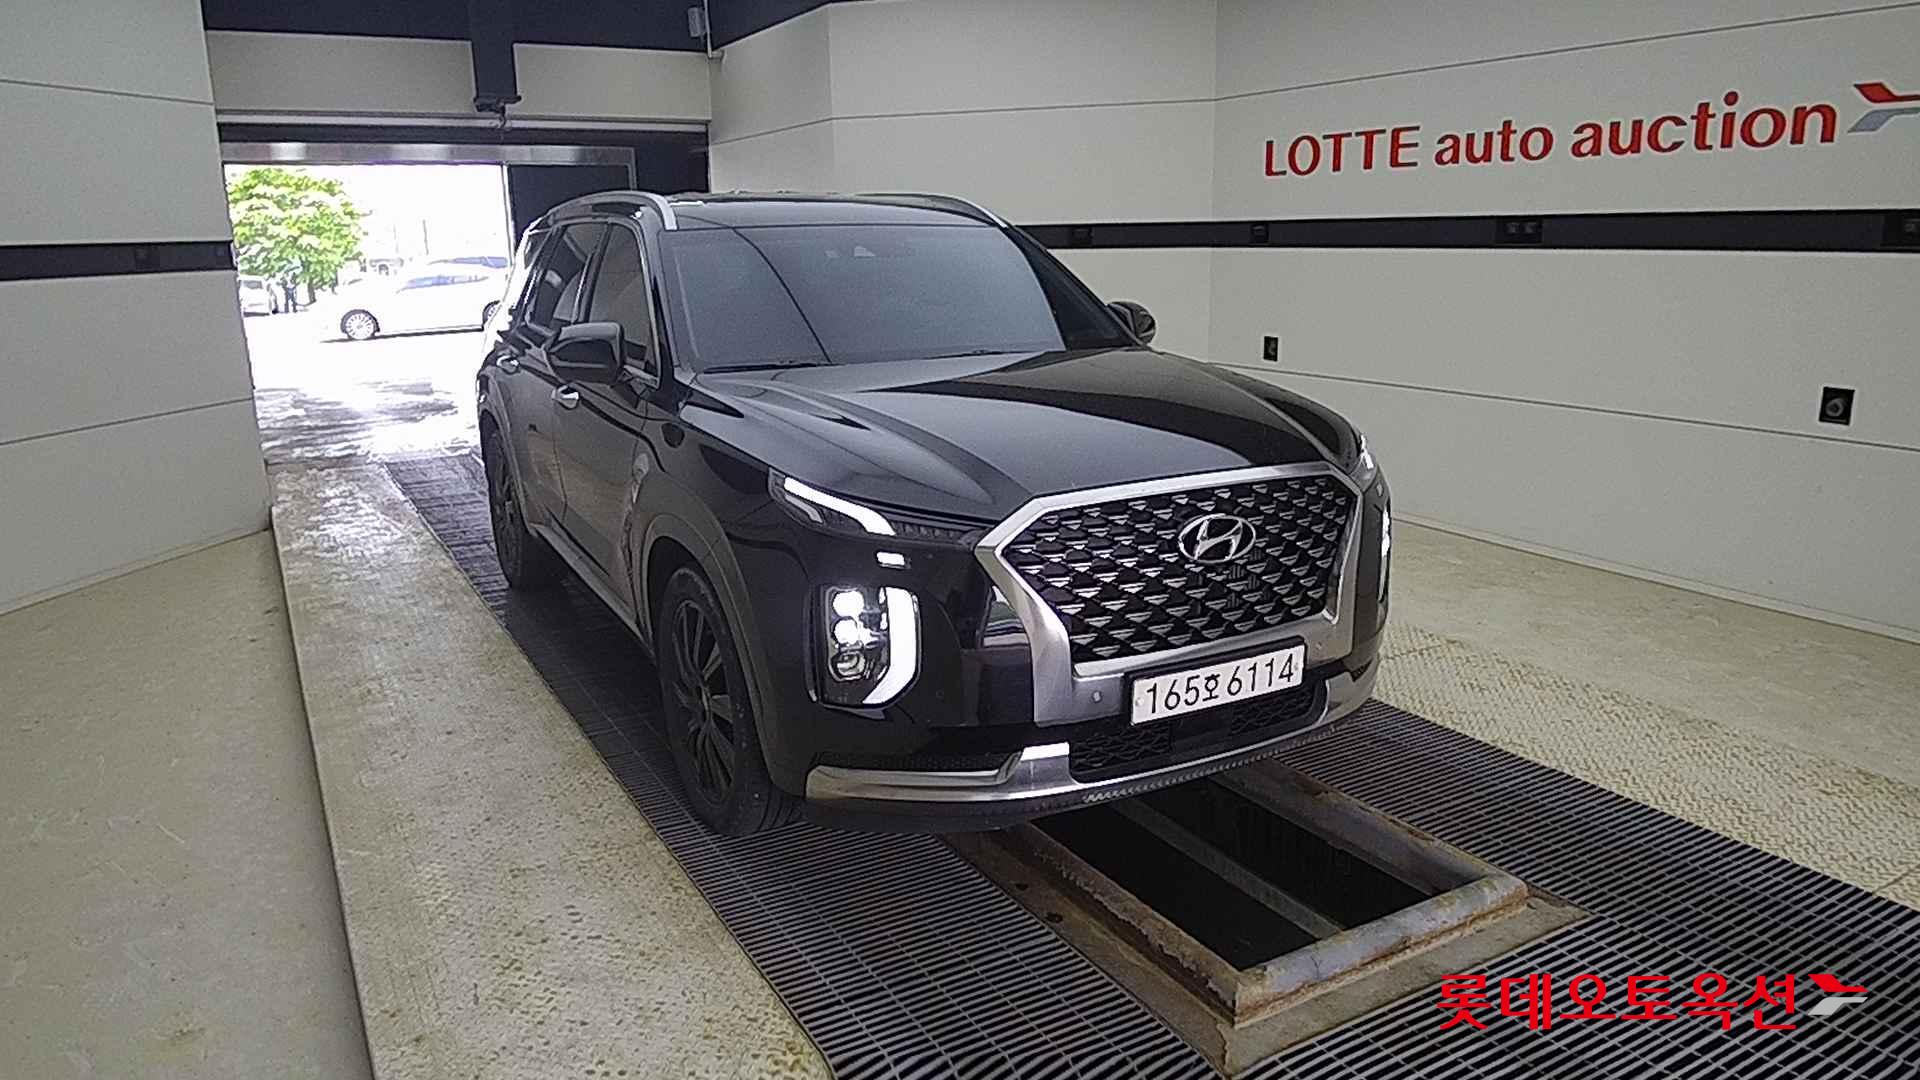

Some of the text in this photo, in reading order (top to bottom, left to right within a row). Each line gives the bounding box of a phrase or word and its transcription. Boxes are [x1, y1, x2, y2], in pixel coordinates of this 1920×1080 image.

[1264, 91, 1838, 177] LOTTE auto auction
